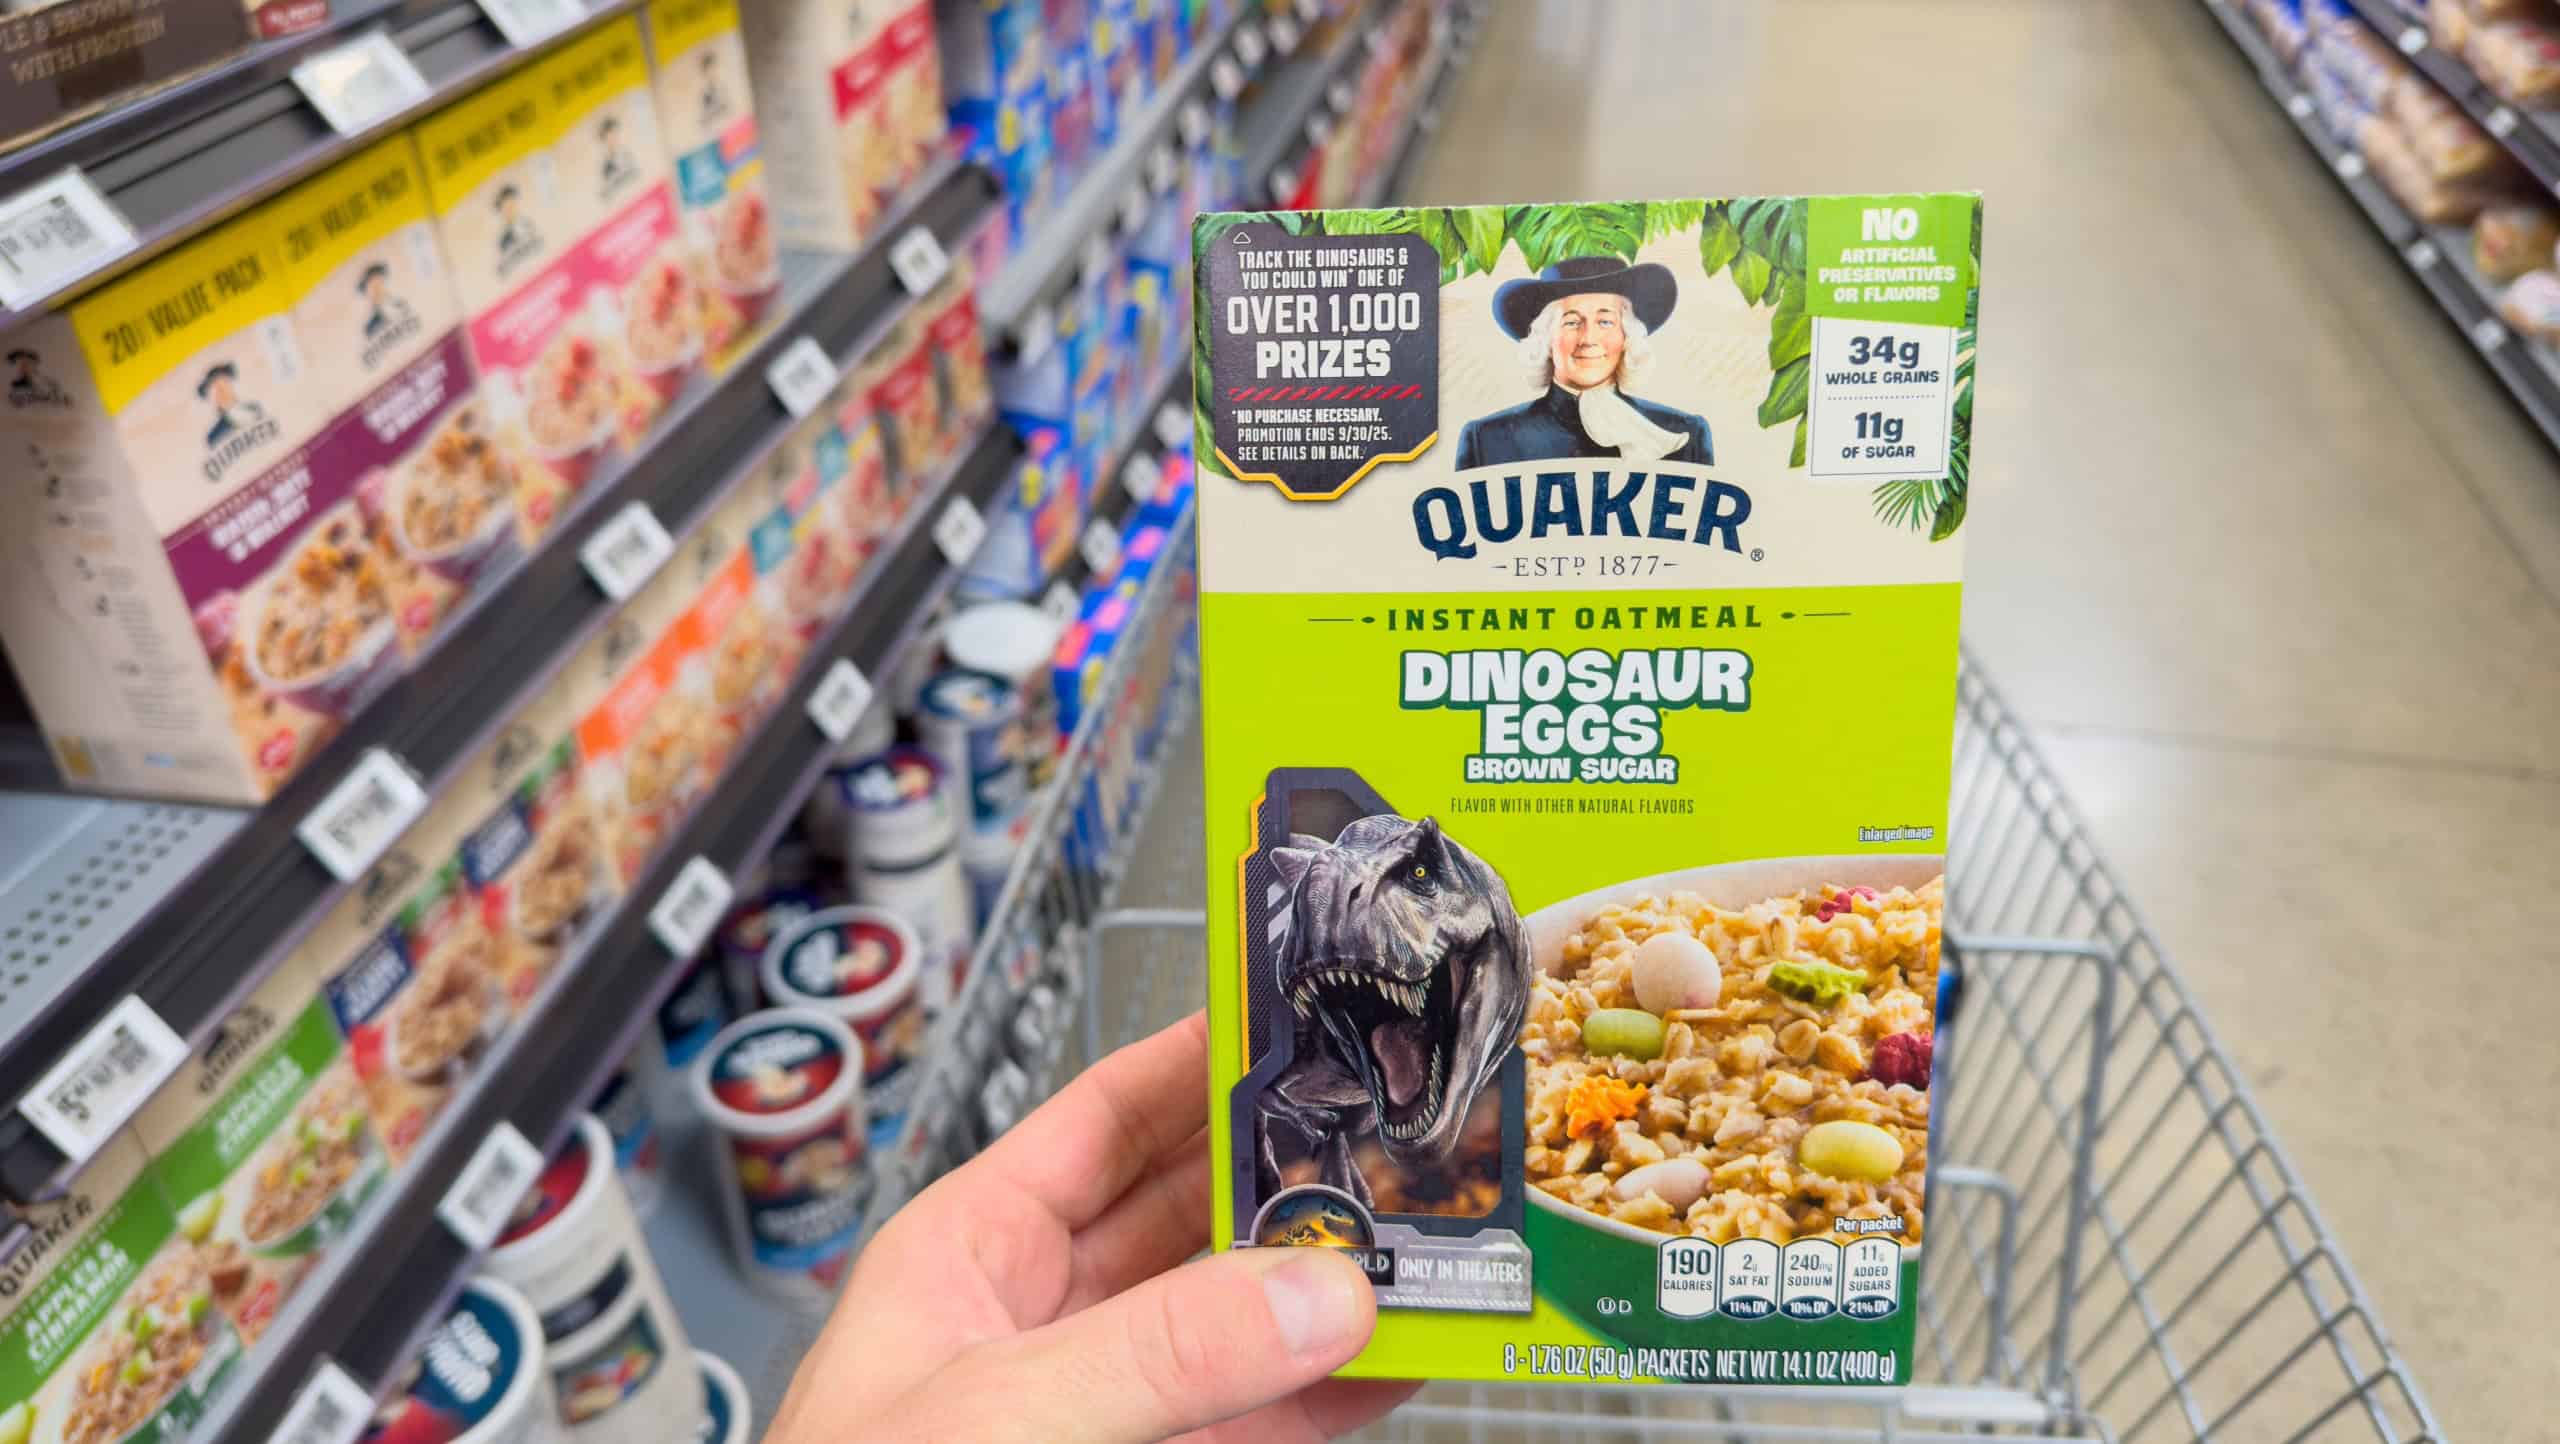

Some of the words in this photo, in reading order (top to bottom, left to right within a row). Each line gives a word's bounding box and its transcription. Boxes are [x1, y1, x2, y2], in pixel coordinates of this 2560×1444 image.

[1862, 208, 1918, 241] NO
[1238, 250, 1282, 270] TRACK
[1287, 250, 1312, 268] THE
[1316, 248, 1394, 268] DINOSAURS
[1398, 248, 1408, 266] &
[1840, 247, 1937, 264] ARTIFICIAL
[1242, 271, 1268, 290] YOU
[1272, 270, 1316, 289] COULD
[1357, 269, 1384, 287] ONE
[1388, 268, 1405, 286] OF
[1818, 266, 1958, 284] PRESERVATIVES
[147, 281, 215, 338] VALUE
[214, 253, 266, 303] PACK
[1834, 287, 1859, 303] OR
[1864, 286, 1940, 302] FLAVORS
[1227, 294, 1318, 334] OVER
[1328, 292, 1420, 336] 1,000
[1256, 339, 1392, 379] PRIZES
[1848, 336, 1920, 369] 34g
[1826, 371, 1878, 385] WHOLE
[1882, 370, 1940, 384] GRAINS
[1256, 409, 1312, 424] PURCHASE
[1315, 408, 1382, 423] NECESSARY.
[1238, 427, 1302, 442] PROMOTION
[1306, 427, 1334, 442] ENDS
[1338, 426, 1392, 441] 9/30/25.
[1855, 412, 1904, 443] 11g
[1238, 446, 1260, 461] SEE
[1262, 446, 1306, 460] DETAILS
[1310, 446, 1326, 460] ON
[1330, 446, 1364, 460] BACK.
[1842, 446, 1860, 459] OF
[1866, 446, 1916, 458] SUGAR
[1598, 554, 1660, 576] 1877
[1388, 608, 1556, 631] INSTANT
[1575, 605, 1762, 630] OATMEAL
[1401, 648, 1753, 710] DINOSAUR
[1485, 703, 1661, 755] EGGS
[1466, 757, 1572, 781] BROWN
[1580, 757, 1677, 782] SUGAR
[1450, 798, 1496, 814] FLAVOR
[1500, 798, 1532, 814] WITH
[1536, 798, 1574, 814] OTHER
[1578, 798, 1634, 814] NATURAL
[1640, 798, 1694, 814] FLAVORS
[1859, 826, 1903, 842] Enlarged
[1904, 826, 1934, 840] image
[1834, 1216, 1858, 1232] Per
[1860, 1216, 1904, 1232] packet
[0, 1195, 91, 1297] QUAKER
[1400, 1258, 1434, 1278] ONLY
[1437, 1259, 1453, 1280] IN
[1456, 1260, 1523, 1282] THEATERS
[1666, 1248, 1712, 1275] 190
[1854, 1267, 1888, 1277] ADDED
[1663, 1280, 1712, 1290] CALORIES
[1728, 1276, 1748, 1286] SAT
[1752, 1276, 1768, 1286] FAT
[1788, 1276, 1832, 1287] SODIUM
[1848, 1280, 1892, 1292] SUGARS
[1729, 1302, 1750, 1314] 11%
[1752, 1301, 1768, 1313] DV
[1790, 1302, 1812, 1313] 10%
[1814, 1301, 1828, 1313] DV
[1848, 1302, 1872, 1313] 21%
[1874, 1300, 1888, 1312] DV
[1503, 1343, 1516, 1373] 8
[1530, 1345, 1562, 1374] 1.76
[1564, 1346, 1585, 1374] OZ
[1588, 1346, 1616, 1377] (50
[1617, 1347, 1634, 1379] g)
[1637, 1348, 1710, 1378] PACKETS
[1716, 1350, 1746, 1378] NET
[1748, 1350, 1777, 1378] WT
[1781, 1350, 1812, 1378] 14.1
[1816, 1350, 1837, 1378] OZ
[1841, 1350, 1876, 1382] (400
[1880, 1351, 1896, 1382] g)
